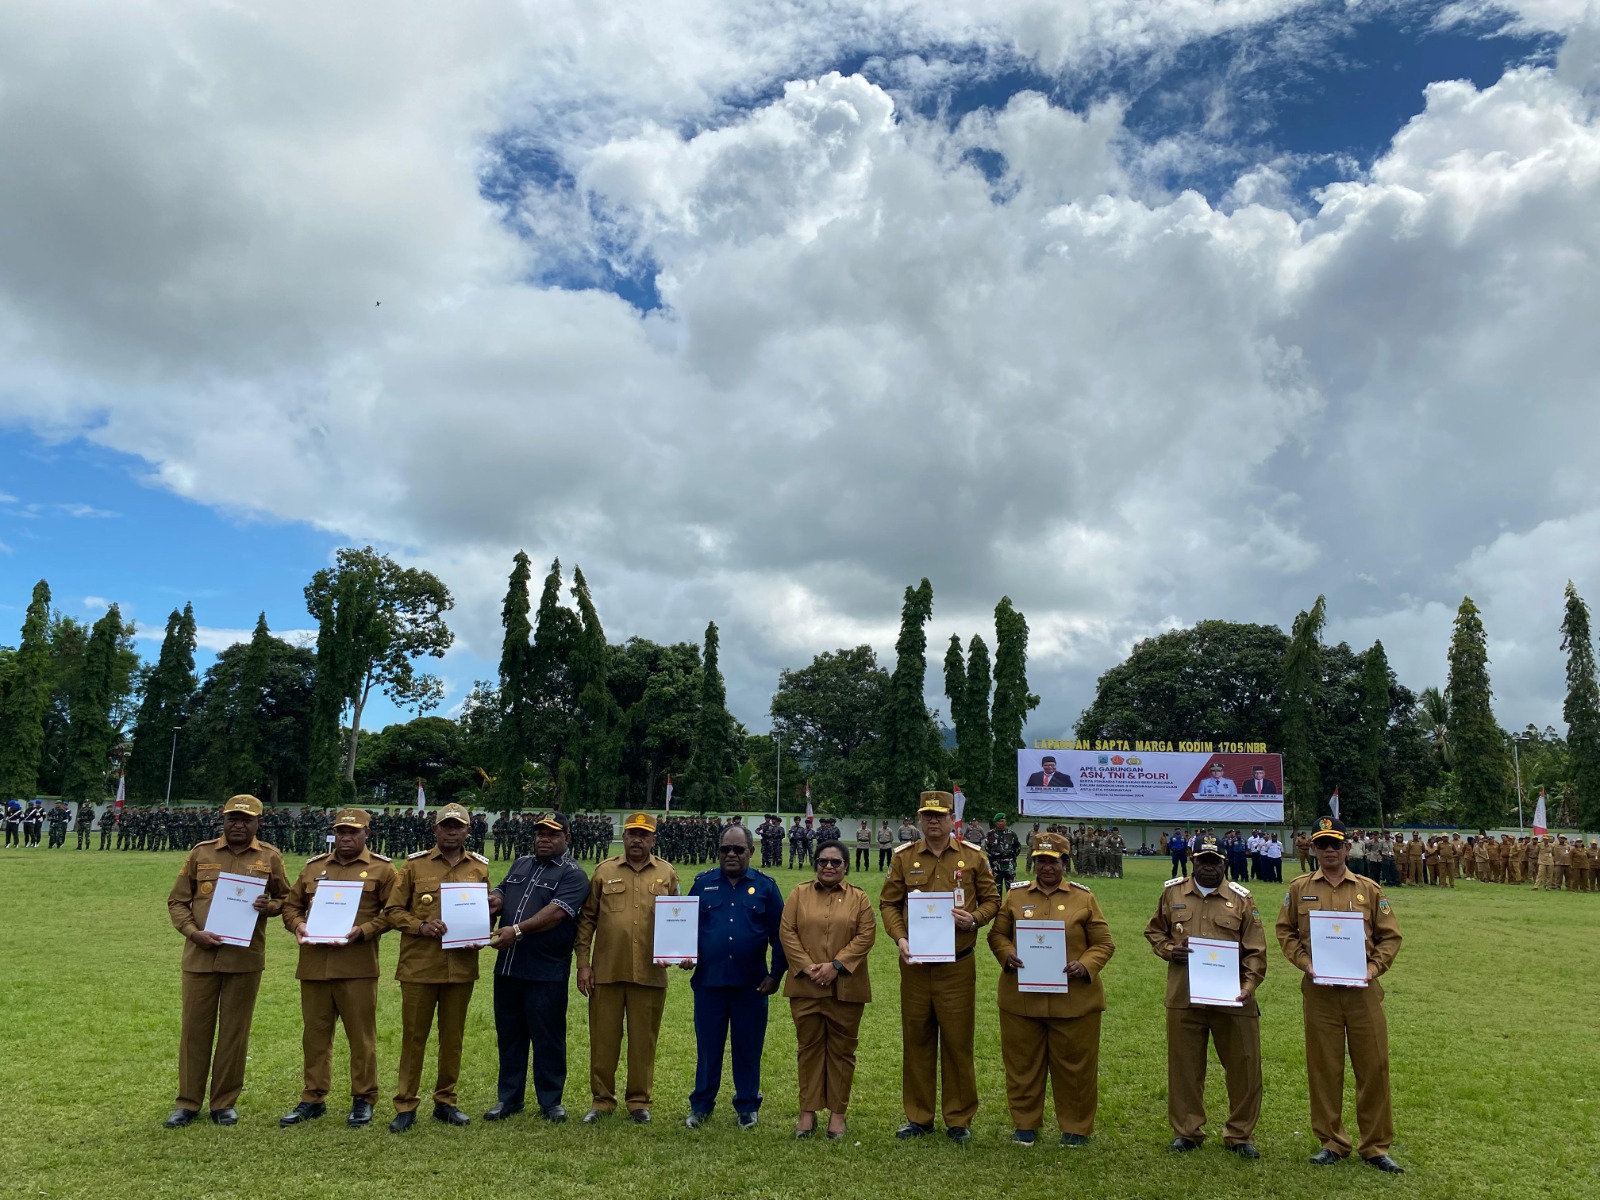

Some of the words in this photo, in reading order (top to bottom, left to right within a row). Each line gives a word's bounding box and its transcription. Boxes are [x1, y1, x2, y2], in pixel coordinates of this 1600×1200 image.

[1096, 740, 1130, 751] SAPTA
[1136, 740, 1174, 752] MARGA
[1178, 741, 1213, 753] KODIM
[1218, 742, 1267, 753] 1705/NBR
